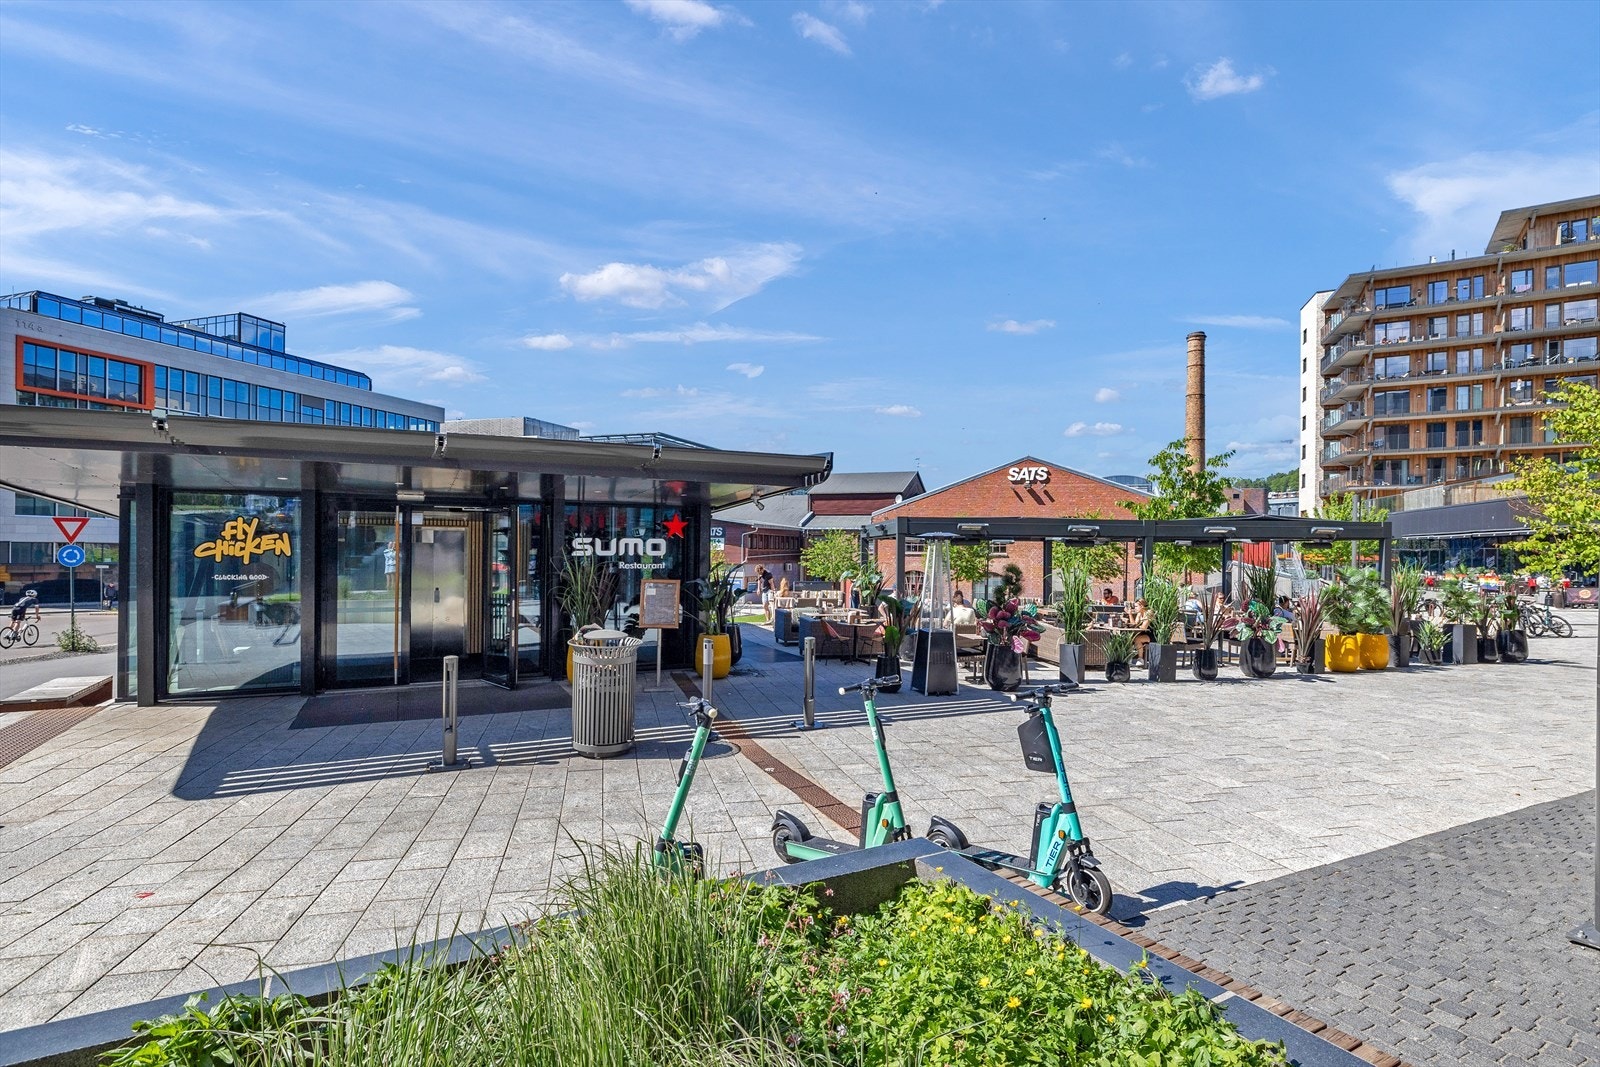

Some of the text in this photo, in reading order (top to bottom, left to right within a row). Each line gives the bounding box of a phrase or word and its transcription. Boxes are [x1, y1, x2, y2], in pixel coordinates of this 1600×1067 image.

[1007, 466, 1049, 481] SATS
[618, 561, 666, 570] Restaurant
[1045, 841, 1061, 867] TIER
